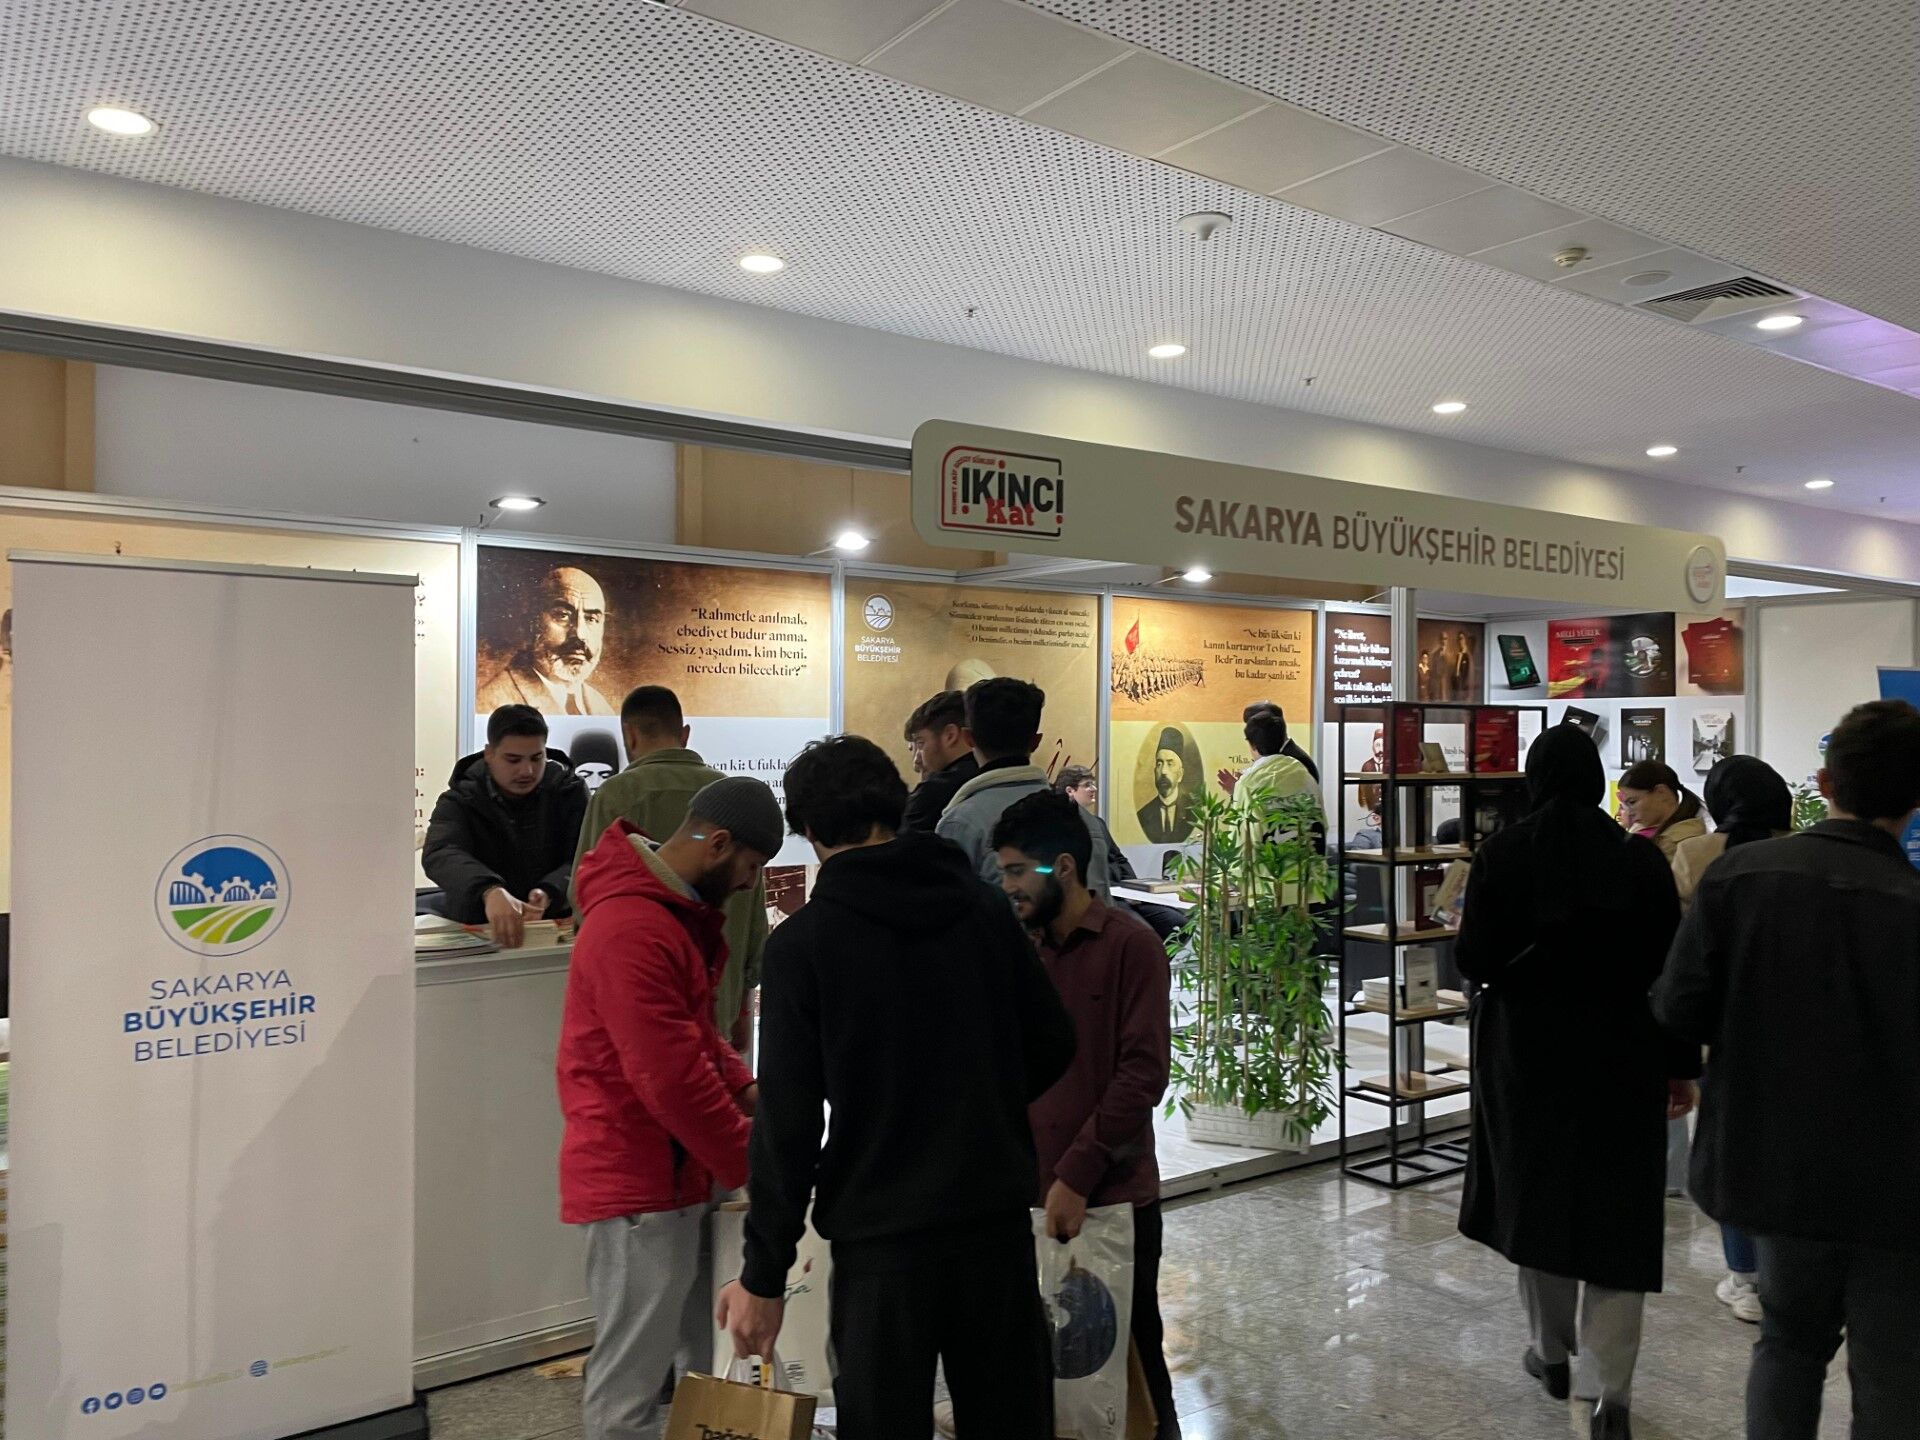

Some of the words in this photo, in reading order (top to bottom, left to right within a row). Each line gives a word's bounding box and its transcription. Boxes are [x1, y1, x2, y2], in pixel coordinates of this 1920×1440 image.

[986, 497, 1034, 526] Kat
[1175, 495, 1323, 548] SAKARYA
[1333, 511, 1496, 567] BÜYÜKŞEHİR
[1504, 537, 1626, 581] BELEDİYESİ
[676, 624, 728, 642] ebediyet
[730, 627, 767, 641] budur
[861, 636, 895, 645] SAKARYA
[1293, 631, 1302, 640] ki
[658, 642, 697, 655] Sessiz
[754, 646, 777, 659] kim
[854, 644, 901, 654] BÜYÜKŞEHİR
[857, 653, 899, 662] BELEDİYESİ
[686, 662, 736, 675] nereden
[1235, 669, 1246, 679] bu
[1246, 669, 1268, 679] kadar
[150, 969, 292, 1000] SAKARYA
[123, 992, 316, 1033] BÜYÜKŞEHİR
[134, 1020, 306, 1063] BELEDİYESİ
